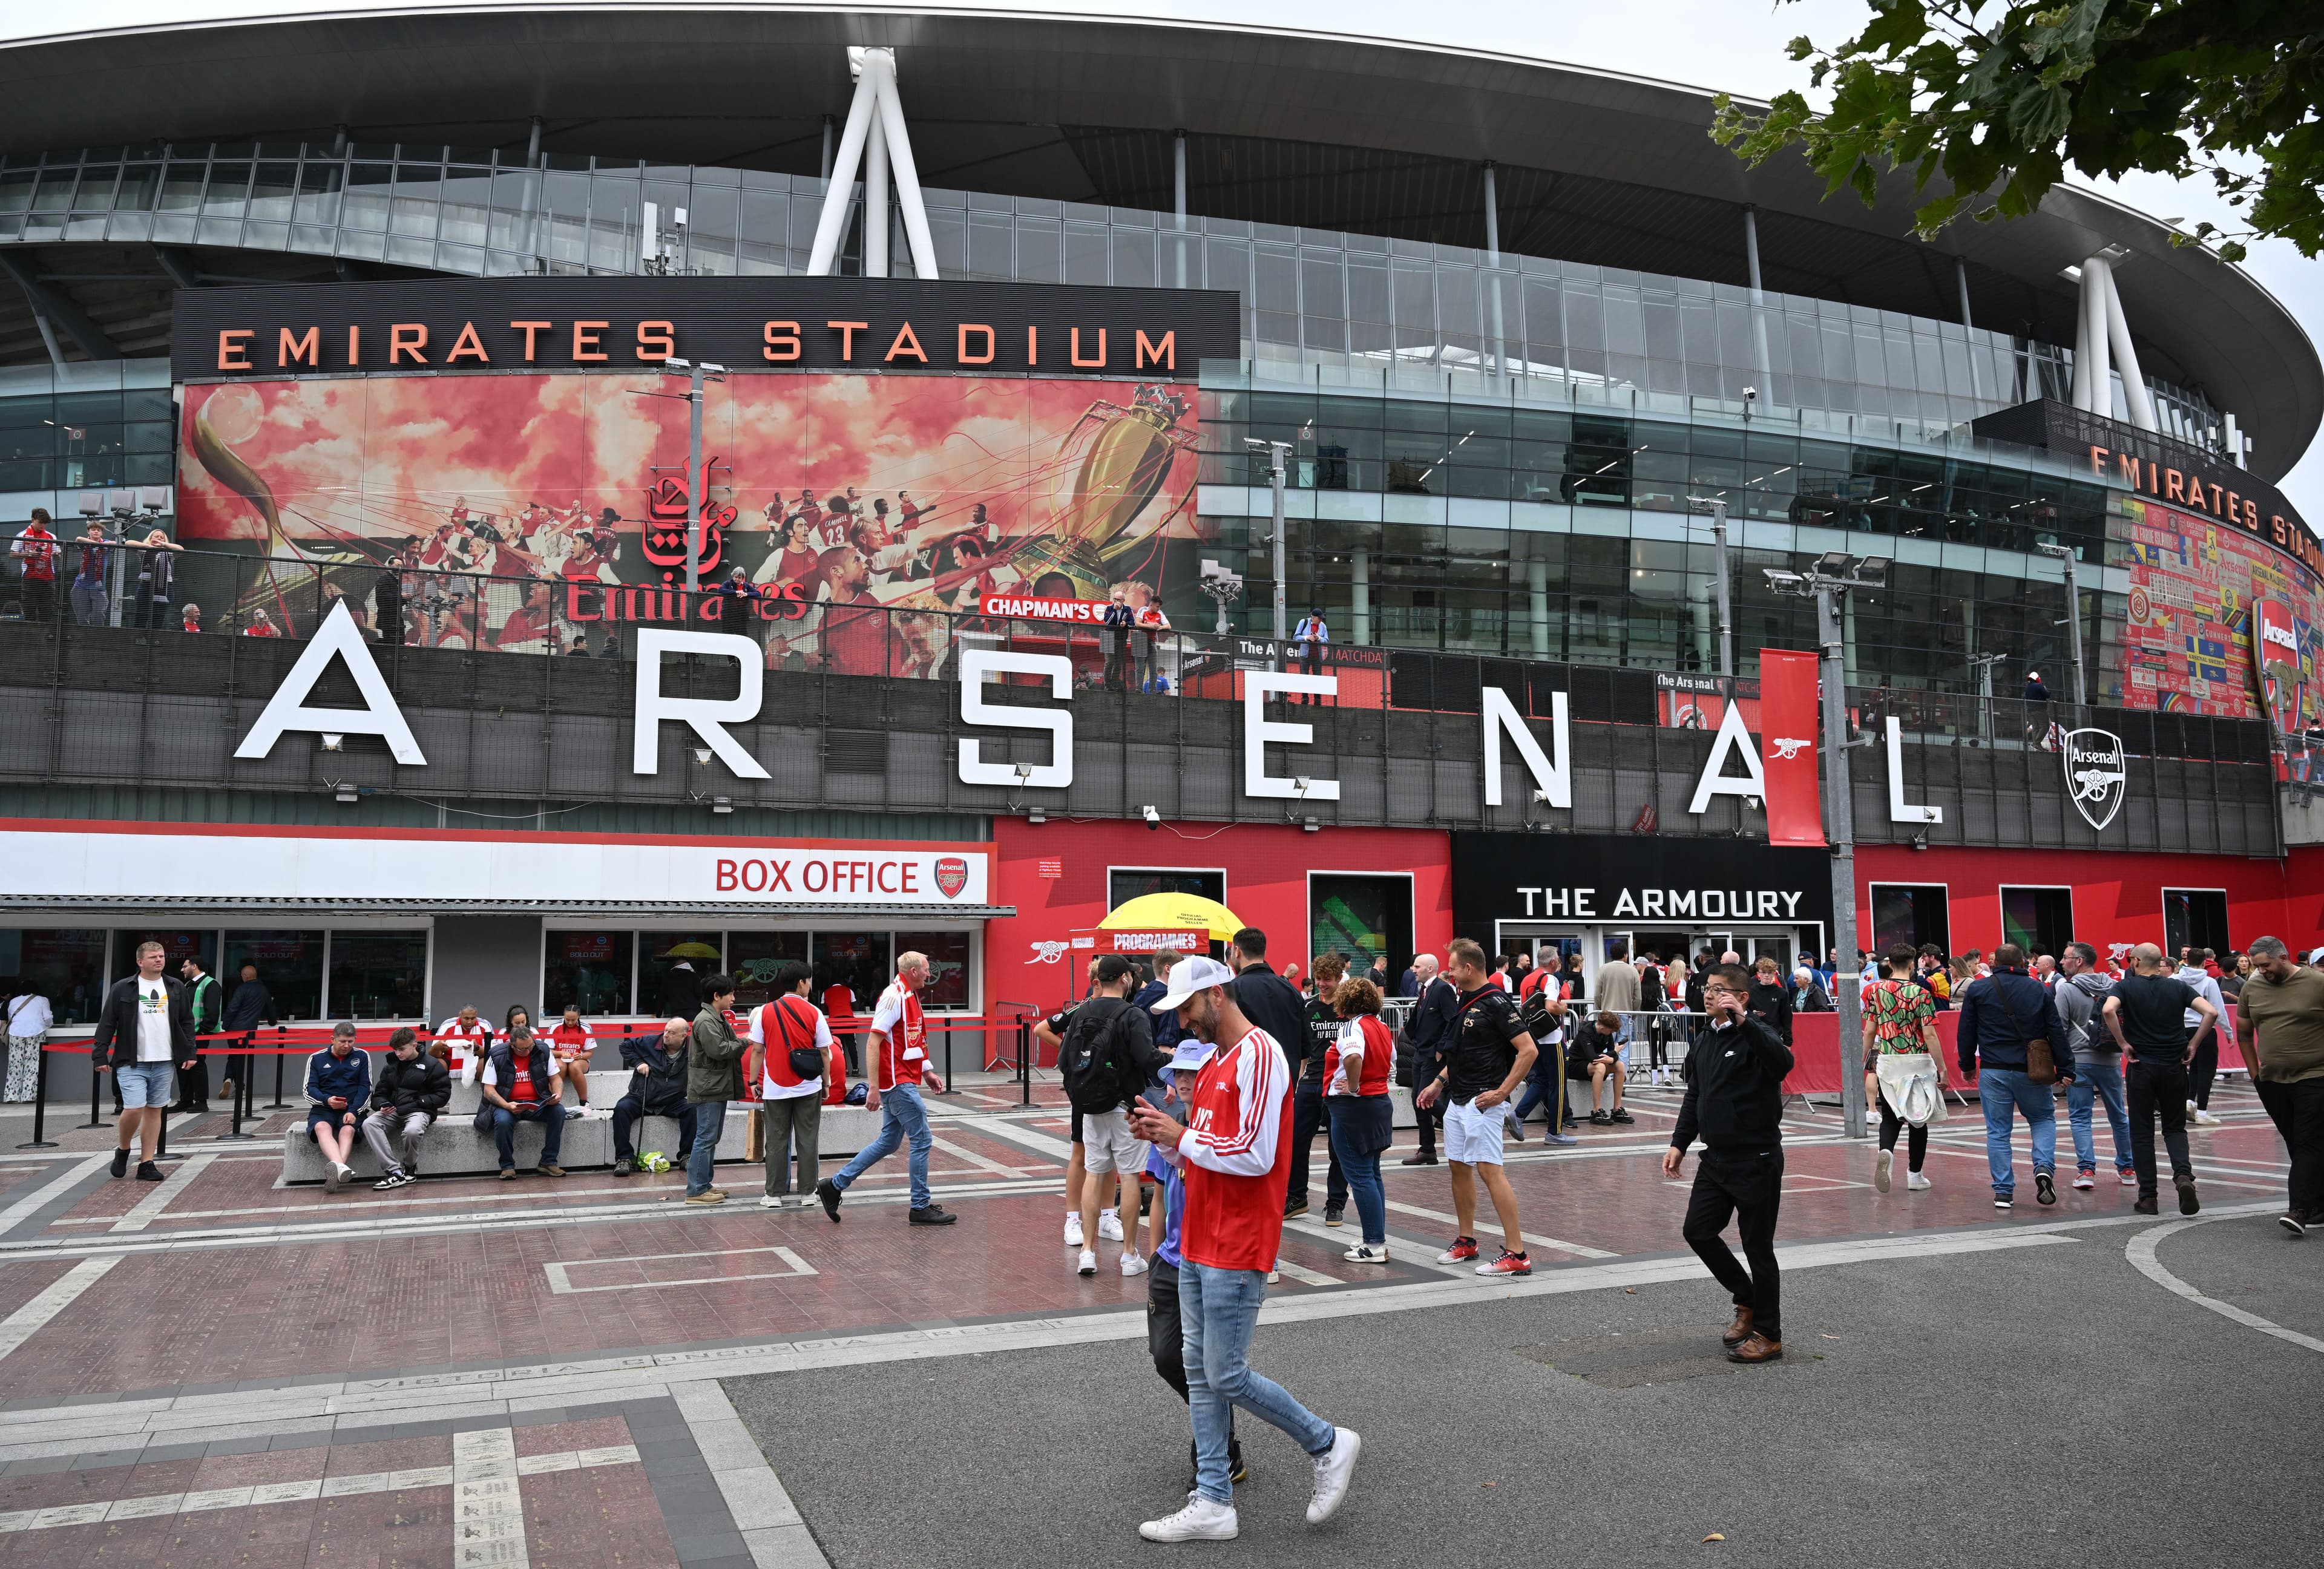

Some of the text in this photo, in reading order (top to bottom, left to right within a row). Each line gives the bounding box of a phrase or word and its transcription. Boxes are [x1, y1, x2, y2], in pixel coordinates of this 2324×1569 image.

[218, 320, 1175, 370] EMIRATES STADIUM
[2090, 445, 2258, 531] EMIRATES
[826, 525, 845, 546] 23
[986, 598, 1091, 620] CHAPMAN'S
[2205, 628, 2231, 643] GUNNERS
[2263, 618, 2297, 650] Arsenal
[1239, 641, 1263, 655] The
[1184, 655, 1204, 670] Arsenal
[2188, 653, 2208, 663] ARSENAL
[2208, 657, 2225, 666] SWEDEN
[1657, 672, 1675, 686] The
[234, 597, 1943, 824] ARSENAL
[2133, 701, 2158, 710] GUNNERS
[2072, 747, 2117, 764] Arsenal
[716, 859, 919, 894] BOX OFFICE
[939, 863, 964, 871] Arsenal
[1517, 887, 1803, 918] THE ARMOURY
[1114, 933, 1196, 951] PROGRAMMES
[1192, 1106, 1213, 1131] JVC
[364, 1320, 1065, 1389] VICTORIA CONCORDIA CRESCIT
